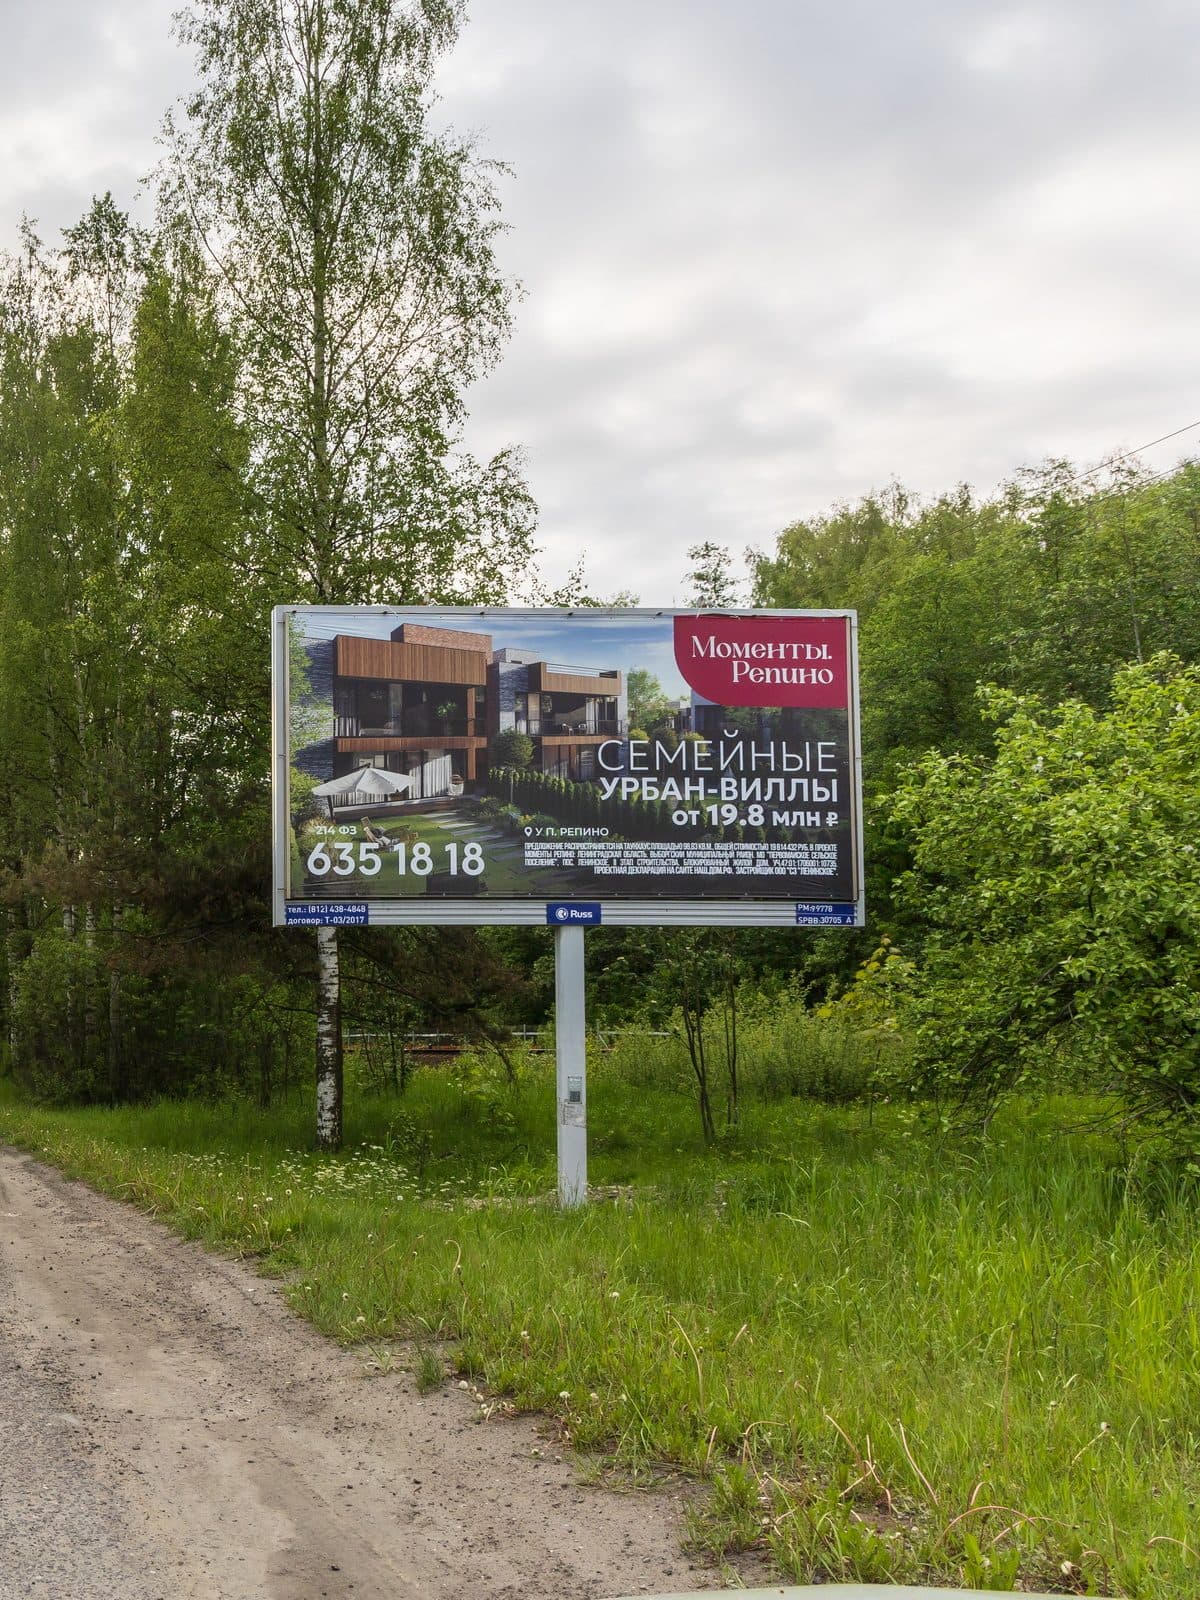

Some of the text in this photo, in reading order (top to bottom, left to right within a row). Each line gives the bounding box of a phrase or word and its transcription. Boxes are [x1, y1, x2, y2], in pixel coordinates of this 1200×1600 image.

[691, 635, 833, 660] Моменты.
[732, 661, 834, 685] Репино
[598, 729, 838, 772] СЕМЕЙНЫЕ
[600, 776, 838, 802] УРБАН-ВИЛЛЫ
[672, 810, 700, 826] от
[706, 804, 765, 826] 19.8
[772, 811, 821, 827] млн
[316, 825, 357, 836] 214 ФЗ
[535, 827, 609, 836] У П. РЕПИНО
[307, 842, 485, 876] 635 18 18
[308, 905, 328, 913] (812)
[329, 905, 366, 913] 438-4848
[570, 909, 592, 918] Russ
